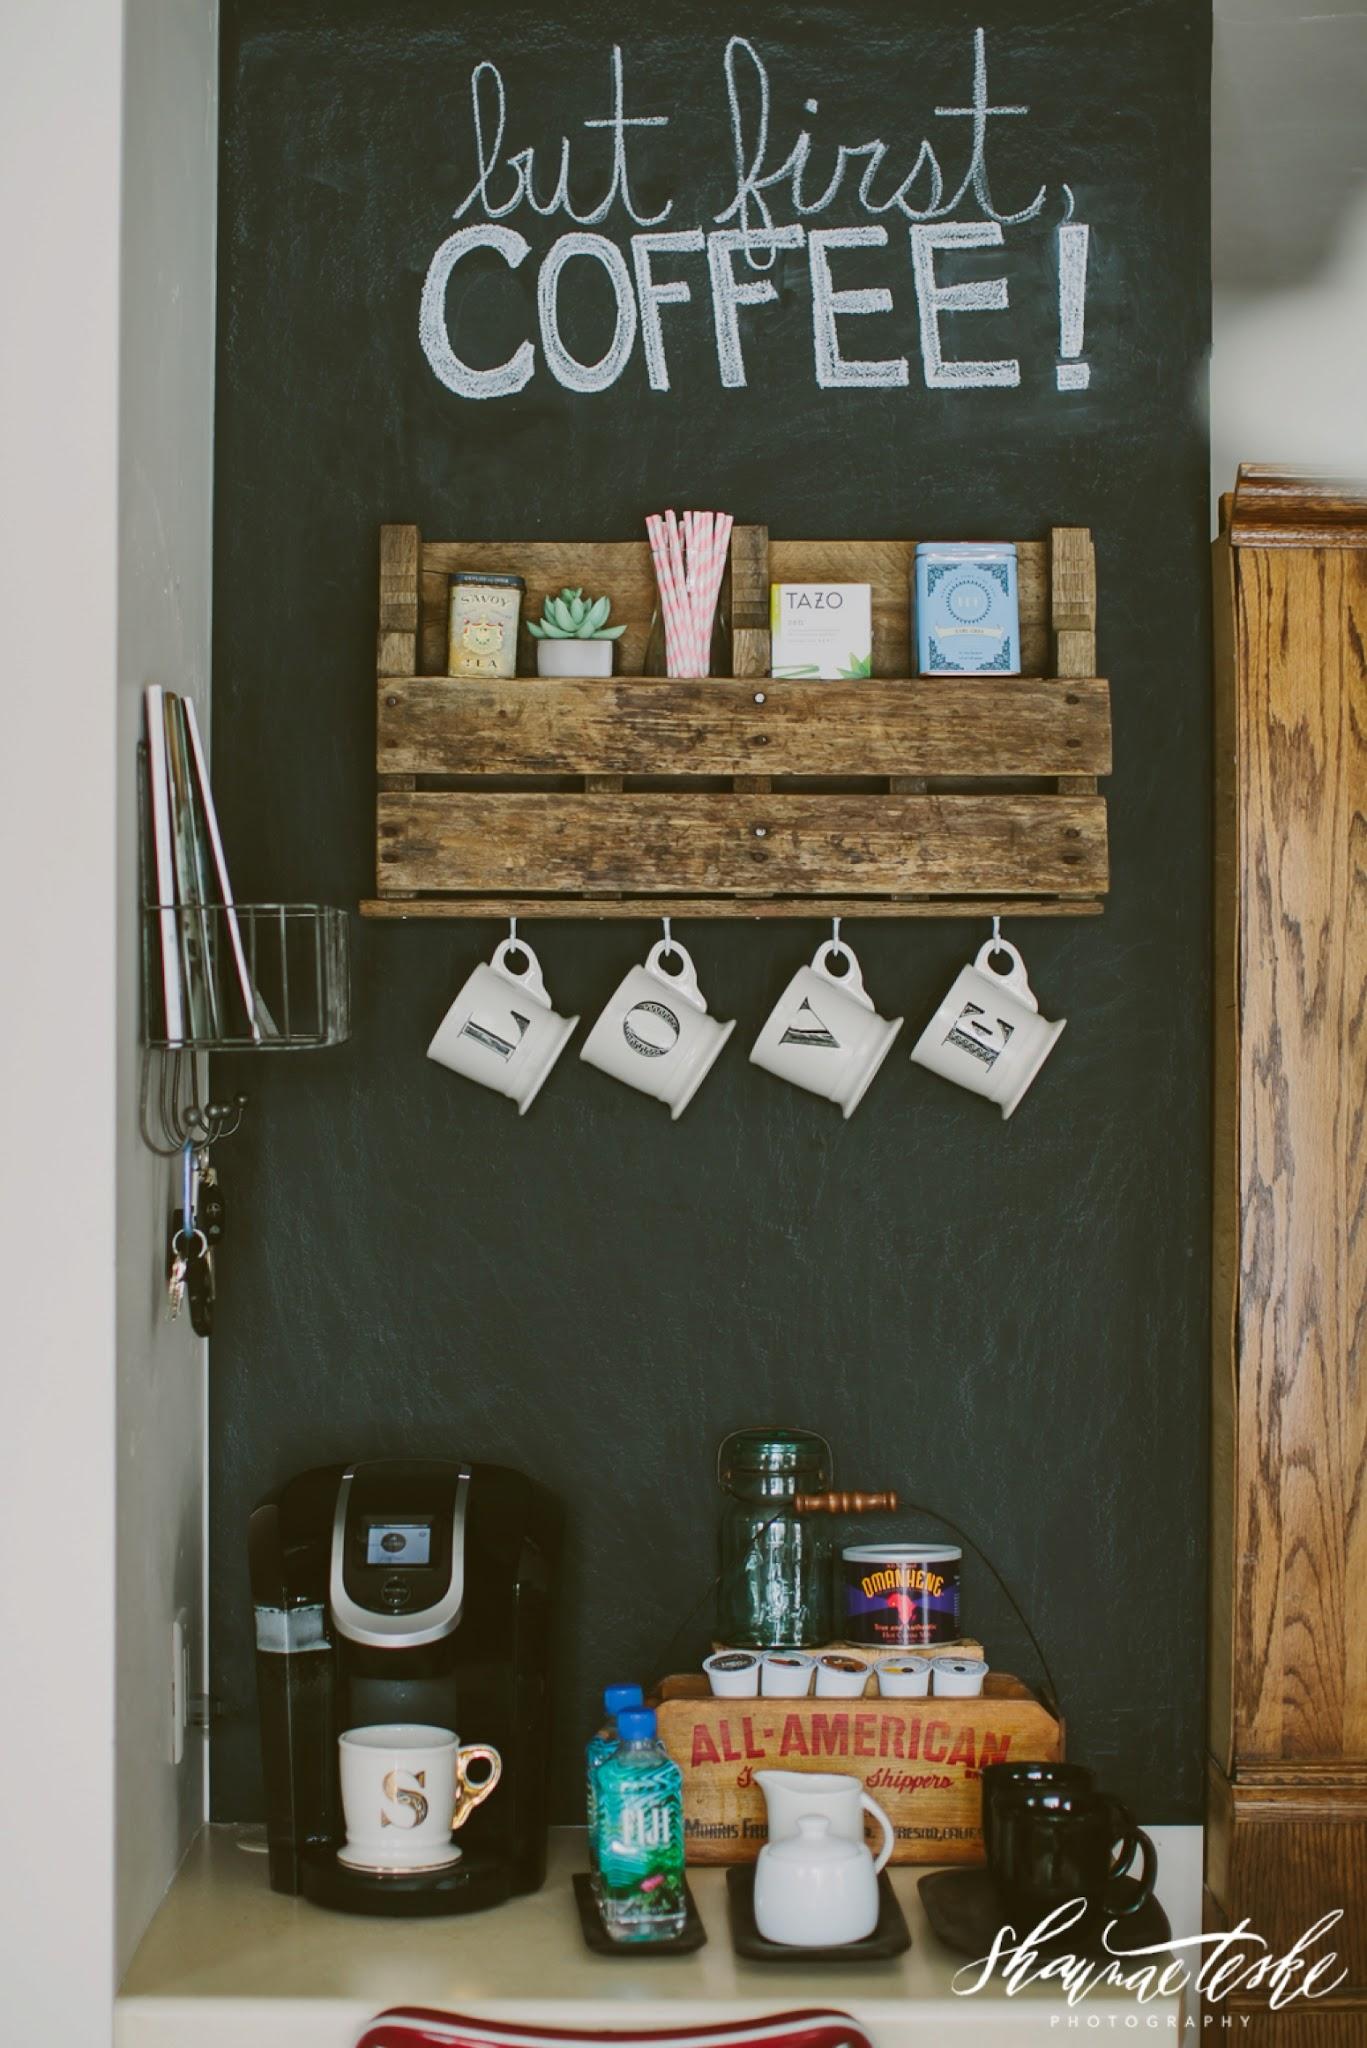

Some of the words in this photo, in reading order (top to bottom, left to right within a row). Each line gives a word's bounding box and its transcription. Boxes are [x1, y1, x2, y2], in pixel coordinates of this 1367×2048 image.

[453, 44, 673, 226] but
[419, 222, 1090, 399] COFFEE!
[785, 592, 843, 609] TAZO
[458, 1009, 531, 1063] L
[622, 1000, 680, 1059] O
[777, 996, 841, 1050] A
[862, 1567, 944, 1598] OMANHENE
[381, 1768, 429, 1829] S
[866, 1768, 954, 1793] Shippers
